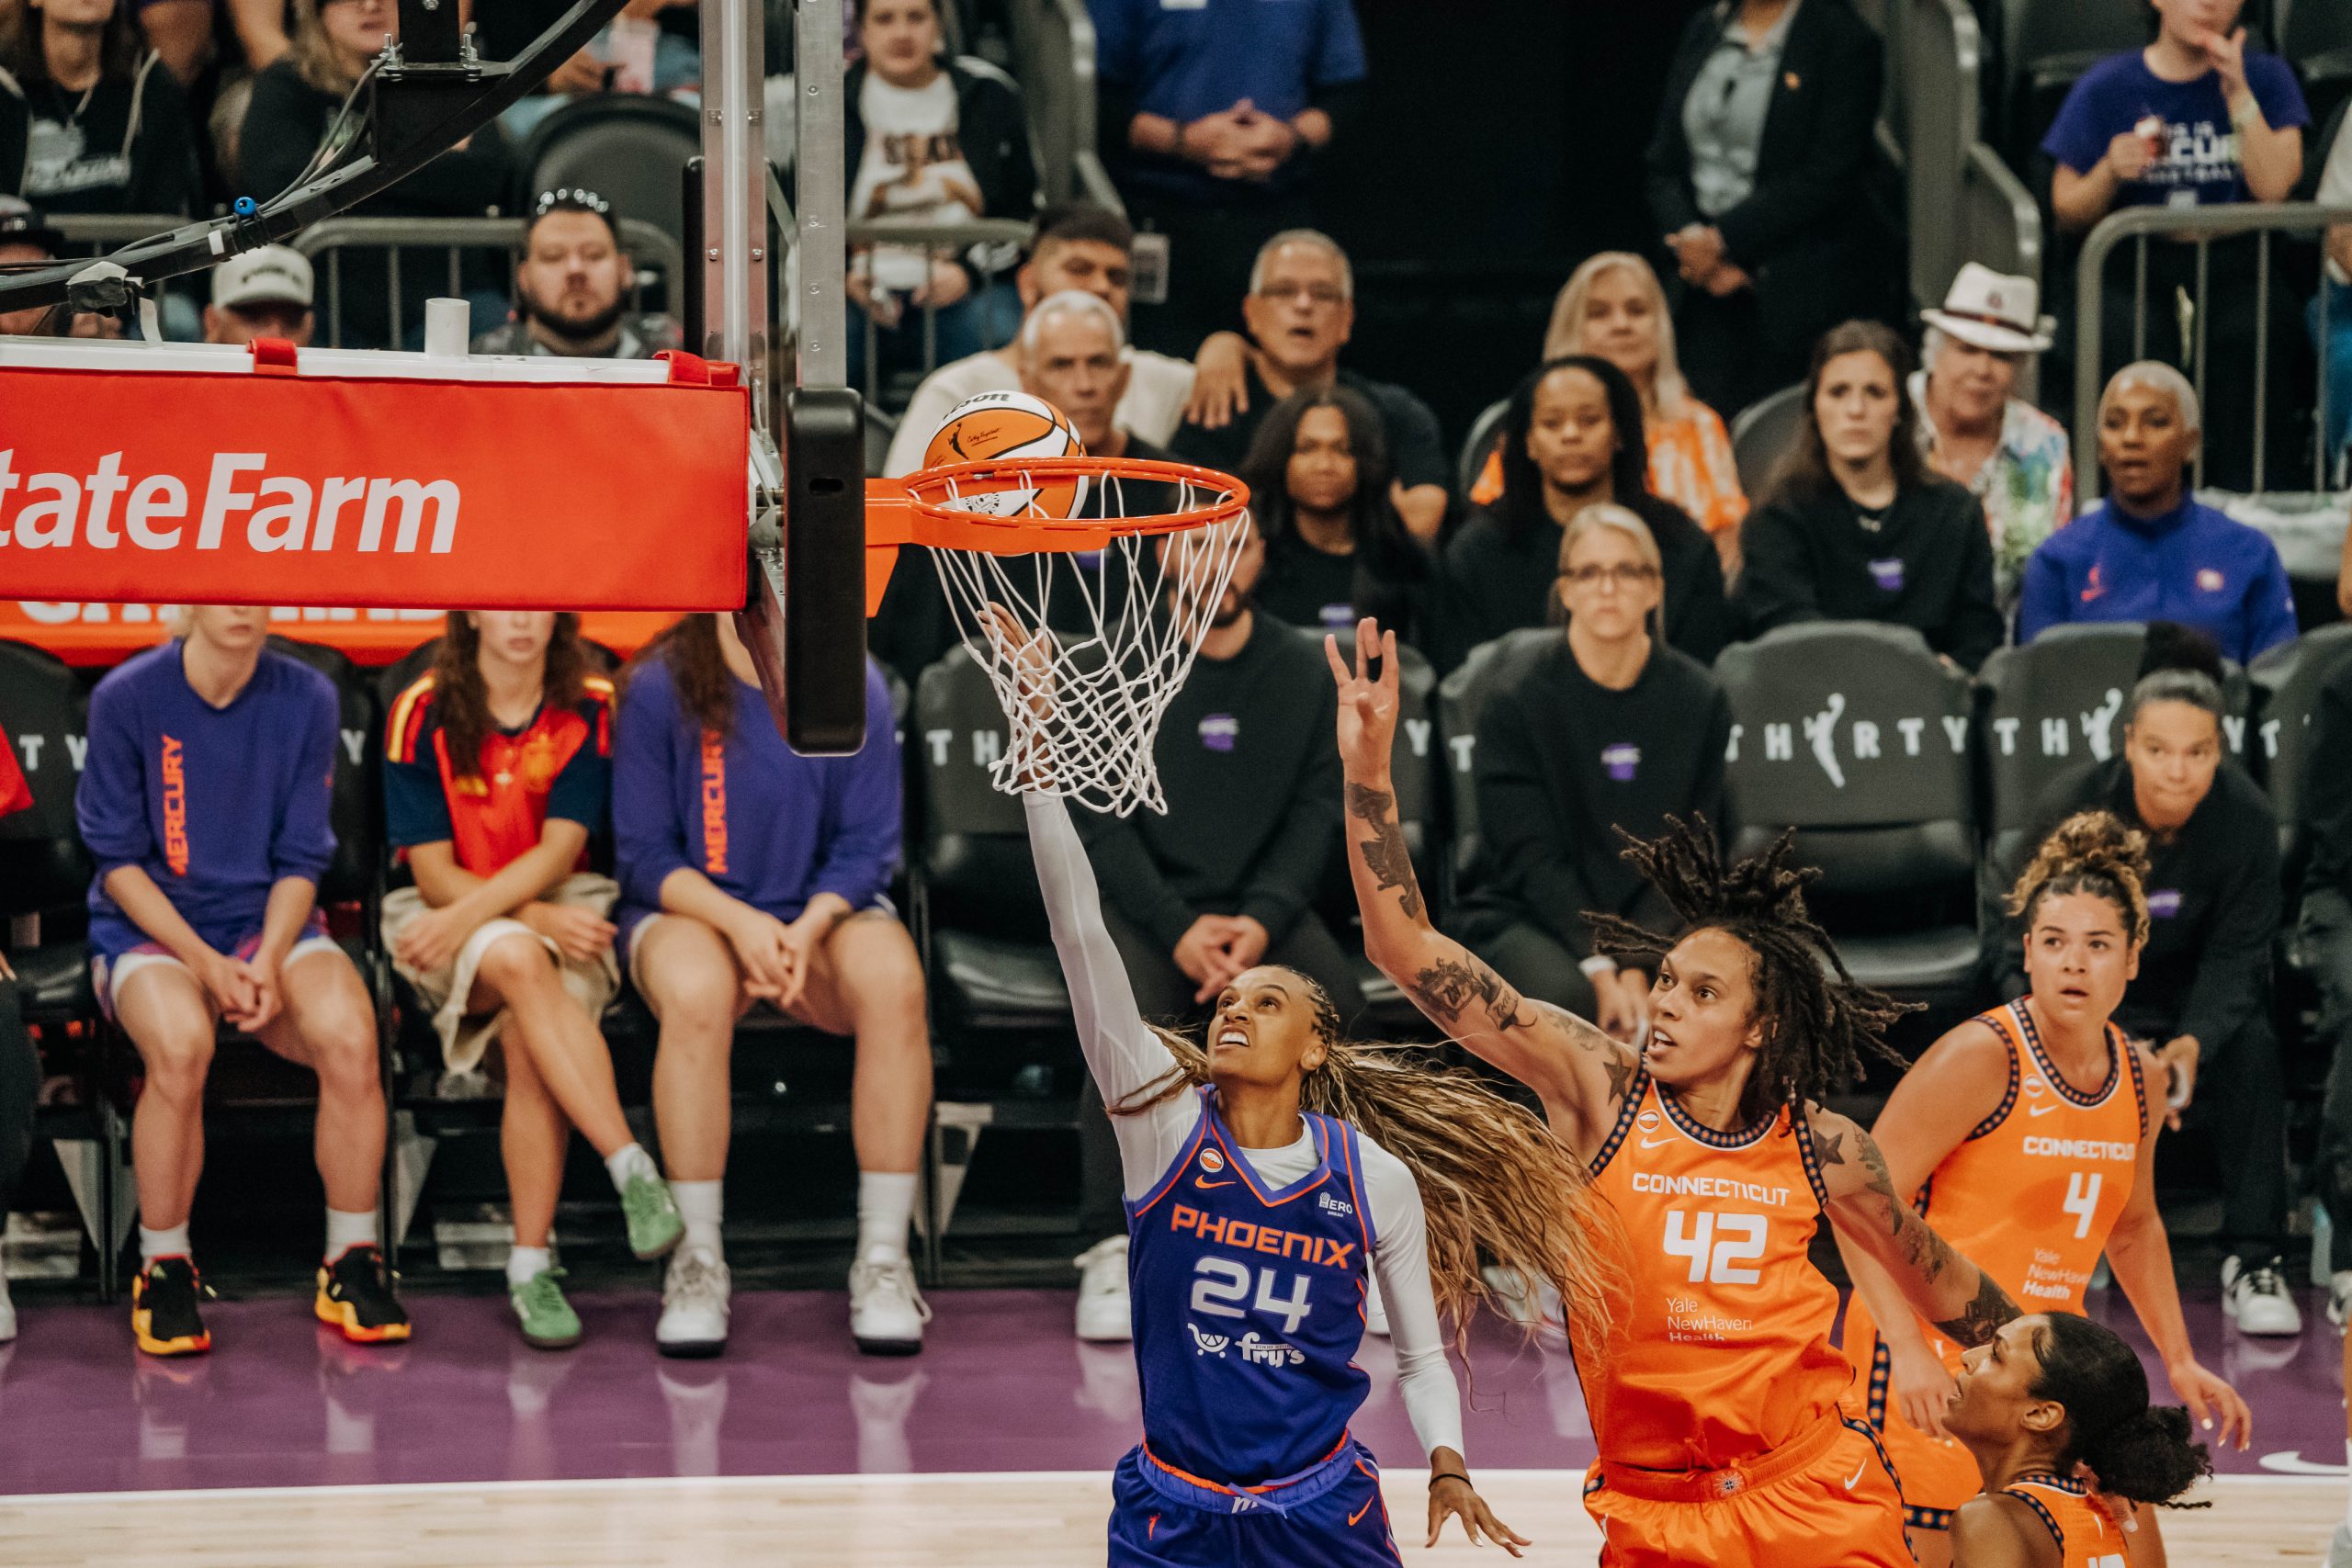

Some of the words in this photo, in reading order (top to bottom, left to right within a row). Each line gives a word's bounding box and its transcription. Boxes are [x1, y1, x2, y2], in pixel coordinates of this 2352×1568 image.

[0, 448, 188, 550] tate
[197, 452, 460, 554] Farm
[2022, 1135, 2136, 1162] CONNECTICU
[1632, 1172, 1791, 1207] CONNECTICUT
[2063, 1172, 2102, 1238] 4
[1170, 1203, 1356, 1269] PHOENIX
[1663, 1210, 1769, 1285] 42
[1190, 1256, 1313, 1334] 24
[1667, 1297, 1699, 1314] Yale
[2022, 1280, 2072, 1301] Health
[1668, 1315, 1752, 1331] NewHaven
[1234, 1335, 1306, 1368] fry's
